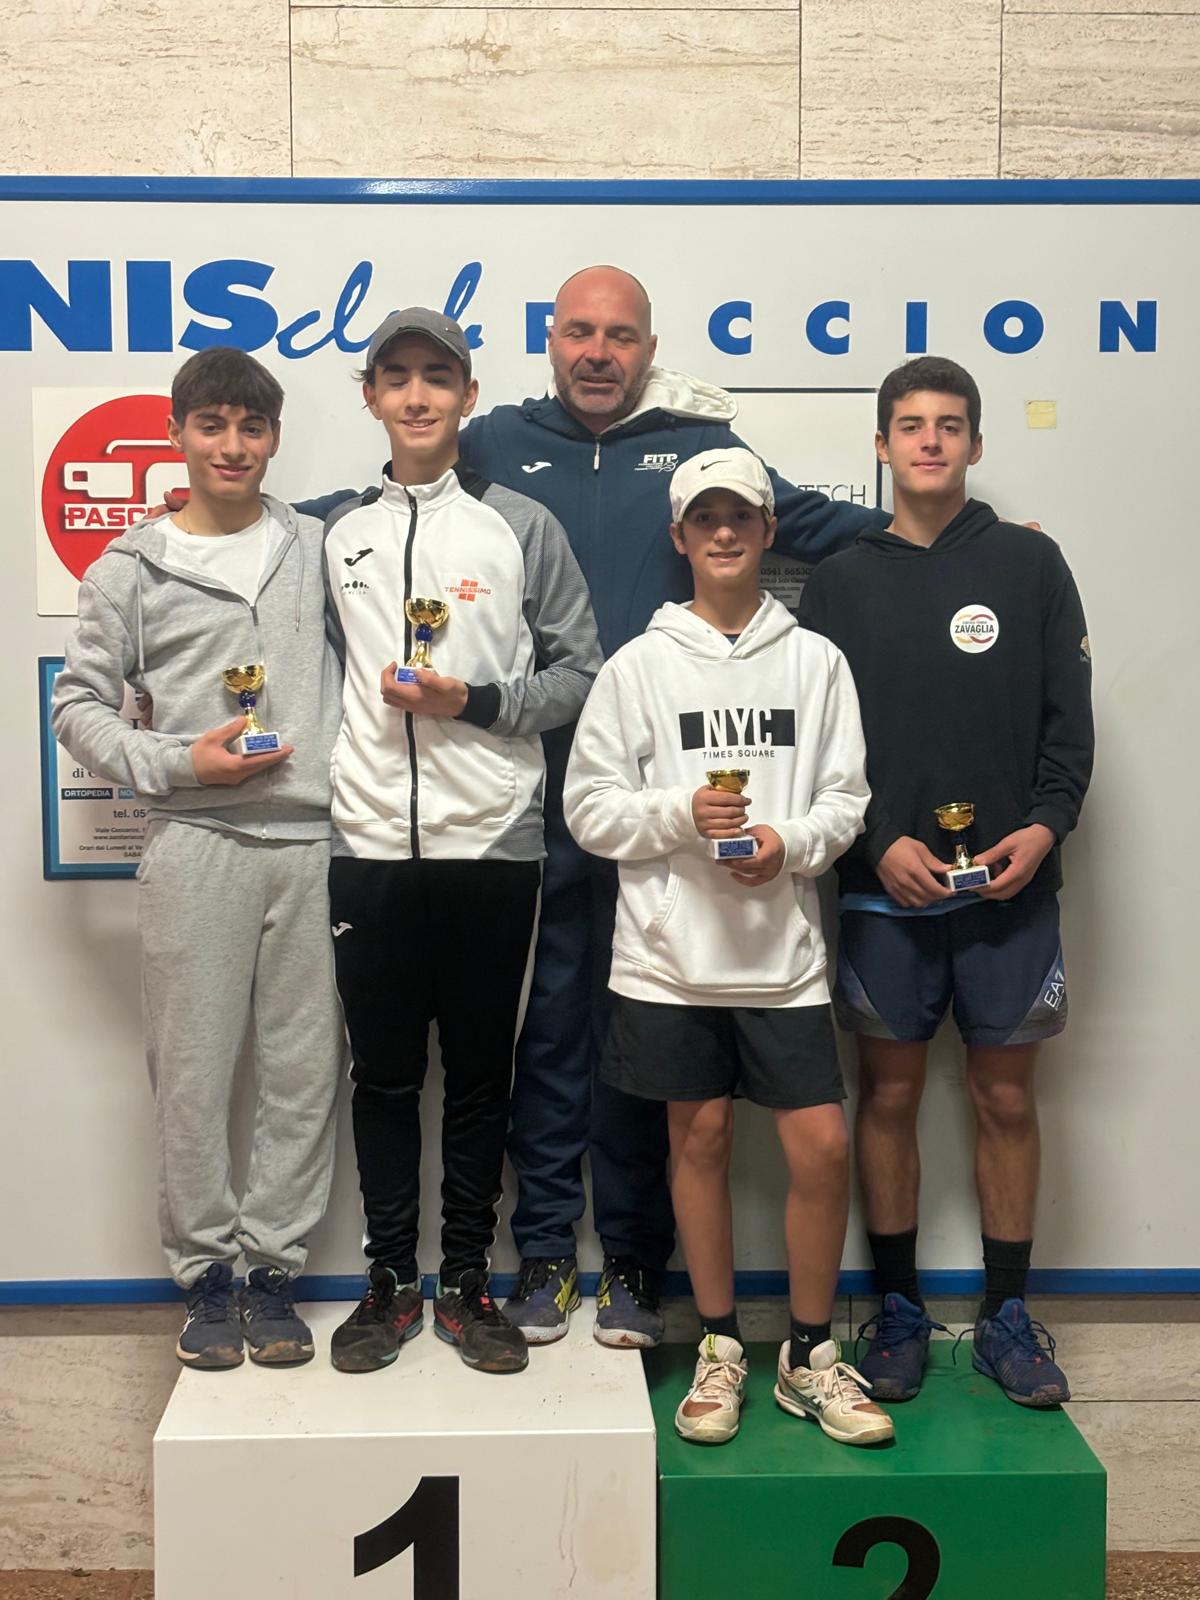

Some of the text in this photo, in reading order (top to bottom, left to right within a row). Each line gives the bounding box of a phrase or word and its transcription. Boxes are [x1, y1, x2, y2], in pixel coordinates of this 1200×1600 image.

[276, 260, 484, 359] clb
[643, 453, 678, 463] FITP
[798, 485, 866, 504] CH
[67, 507, 155, 527] PASC
[444, 586, 491, 595] TENNISSIMO
[954, 624, 995, 634] ZAVAGLIA
[703, 708, 773, 748] NYC
[702, 750, 776, 759] TIMES SQUARE
[72, 768, 84, 778] di
[64, 789, 111, 797] ORTOPEDIA
[113, 809, 147, 818] tel. 05
[354, 1475, 460, 1600] 1
[832, 1515, 942, 1600] 2
